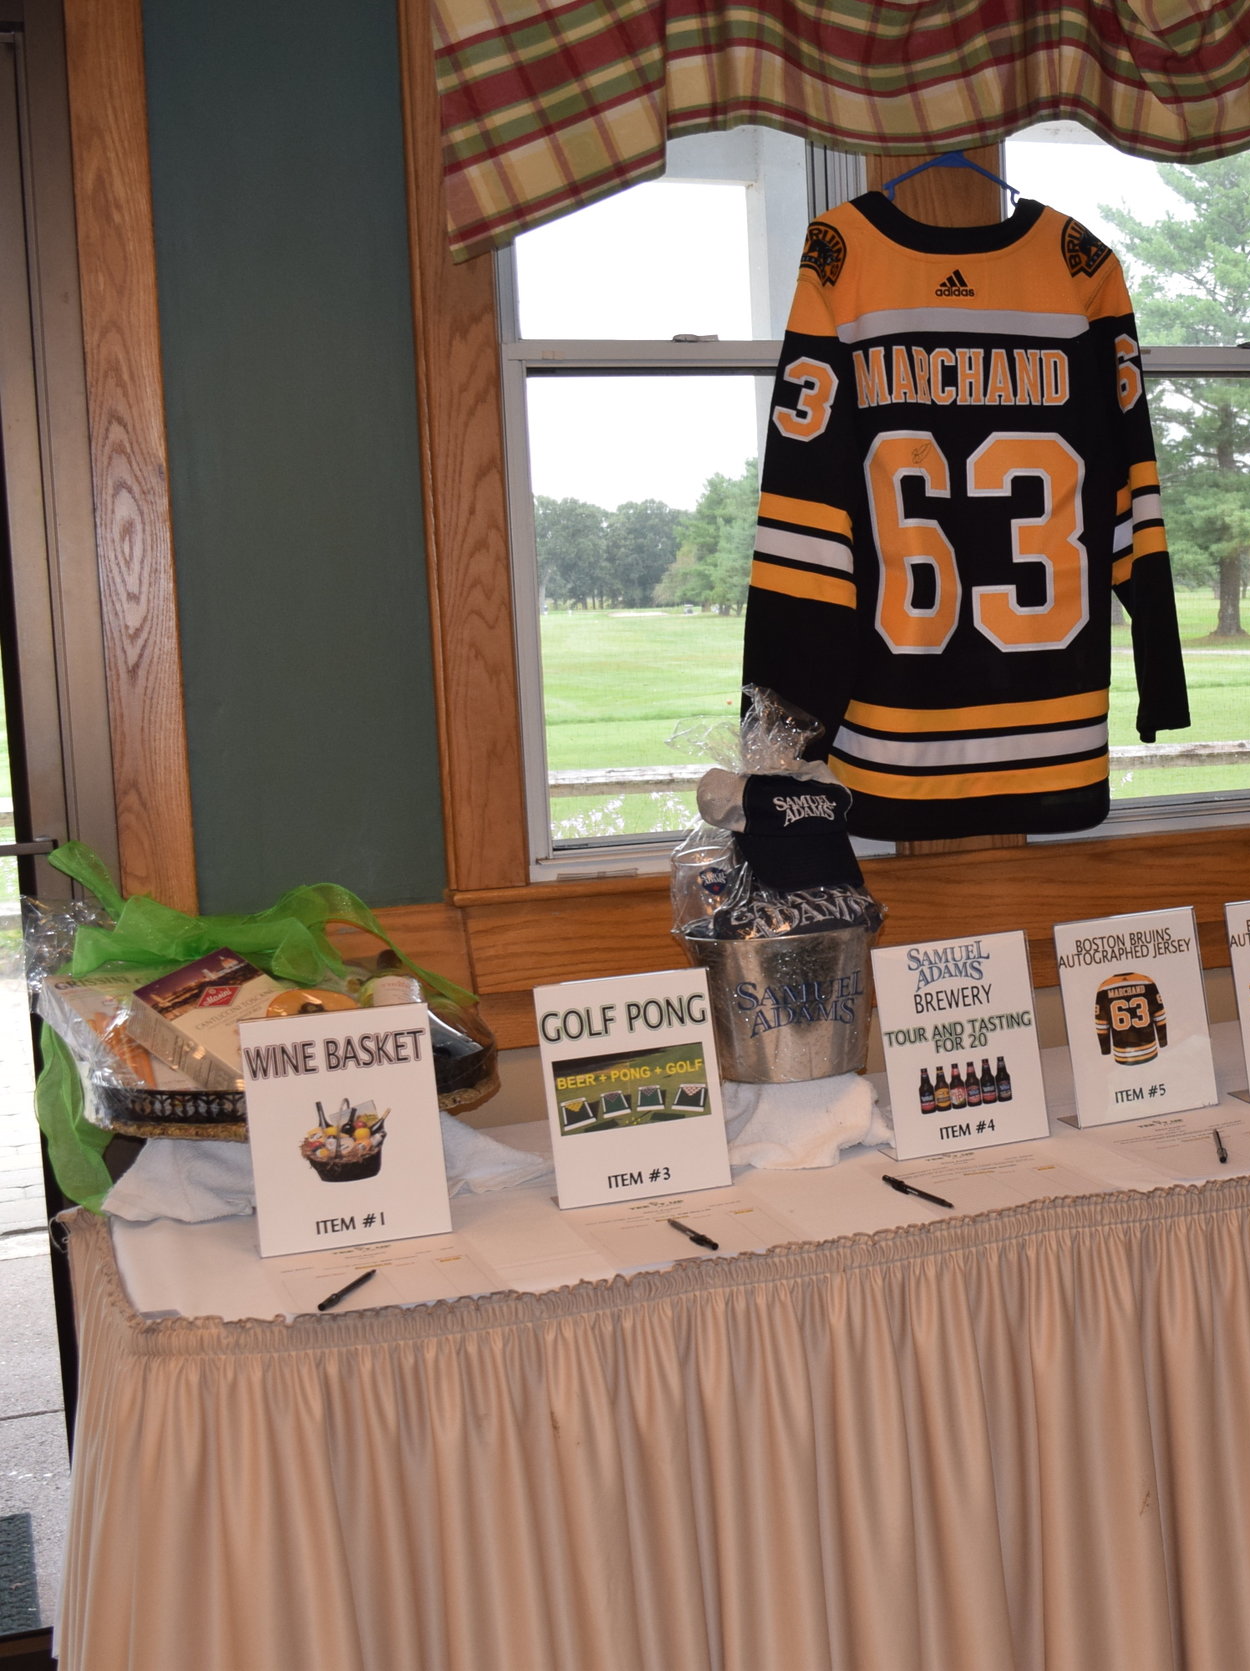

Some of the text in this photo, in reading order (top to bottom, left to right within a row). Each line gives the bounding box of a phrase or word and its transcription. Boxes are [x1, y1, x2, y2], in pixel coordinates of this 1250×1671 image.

[935, 285, 976, 298] adidas
[853, 344, 1070, 409] MARCHAND
[772, 356, 840, 443] 3
[863, 429, 1091, 655] 63
[772, 795, 837, 812] SAMUEL
[783, 803, 836, 827] ADAMS
[907, 940, 990, 972] SAMUEL
[1058, 937, 1192, 970] AUTOGRAPHED JERSEY
[1075, 927, 1172, 954] BOSTON BRUINS
[735, 970, 865, 1013] SAMUEL
[915, 960, 984, 993] ADAMS
[913, 983, 993, 1015] BREWERY
[1110, 996, 1151, 1031] 63
[540, 992, 708, 1044] GOLF PONG
[750, 1000, 857, 1040] ADAMS
[884, 1010, 1033, 1049] TOUR AND TASTING
[243, 1027, 426, 1081] WINE BASKET
[934, 1032, 988, 1055] FOR 20
[556, 1074, 597, 1091] BEER
[610, 1065, 652, 1084] PONG
[666, 1058, 704, 1076] GOLF
[1115, 1082, 1167, 1104] ITEM #5
[939, 1118, 996, 1141] ITEM #4
[608, 1166, 672, 1189] ITEM #3
[315, 1216, 356, 1236] ITEM
